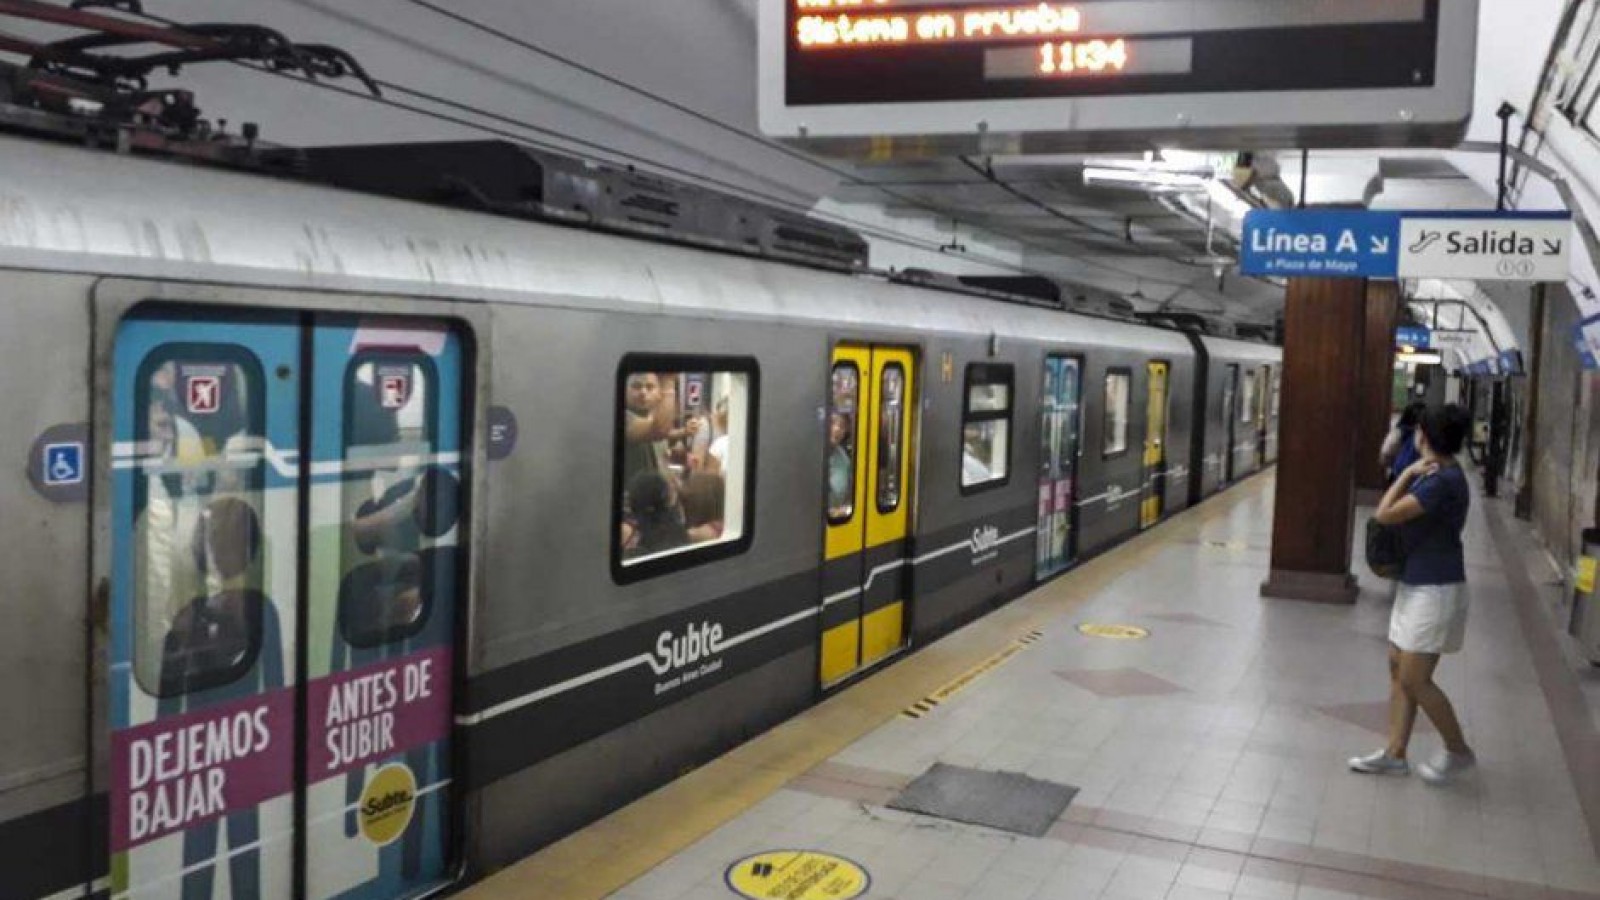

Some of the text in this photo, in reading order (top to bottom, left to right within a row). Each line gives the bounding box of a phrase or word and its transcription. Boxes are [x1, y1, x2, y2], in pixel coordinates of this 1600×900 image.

[797, 2, 1080, 46] Sistema en prueba
[1039, 38, 1127, 73] 11:34
[1252, 227, 1358, 253] Línea A
[1446, 230, 1534, 255] Salida
[1276, 258, 1305, 270] Plaza
[1308, 258, 1323, 270] de
[1326, 259, 1359, 272] Mayo
[653, 621, 723, 675] Subte
[325, 657, 432, 728] ANTES DE
[130, 705, 270, 790] DEJEMOS
[325, 711, 395, 770] SUBIR
[130, 767, 226, 841] BAJAR
